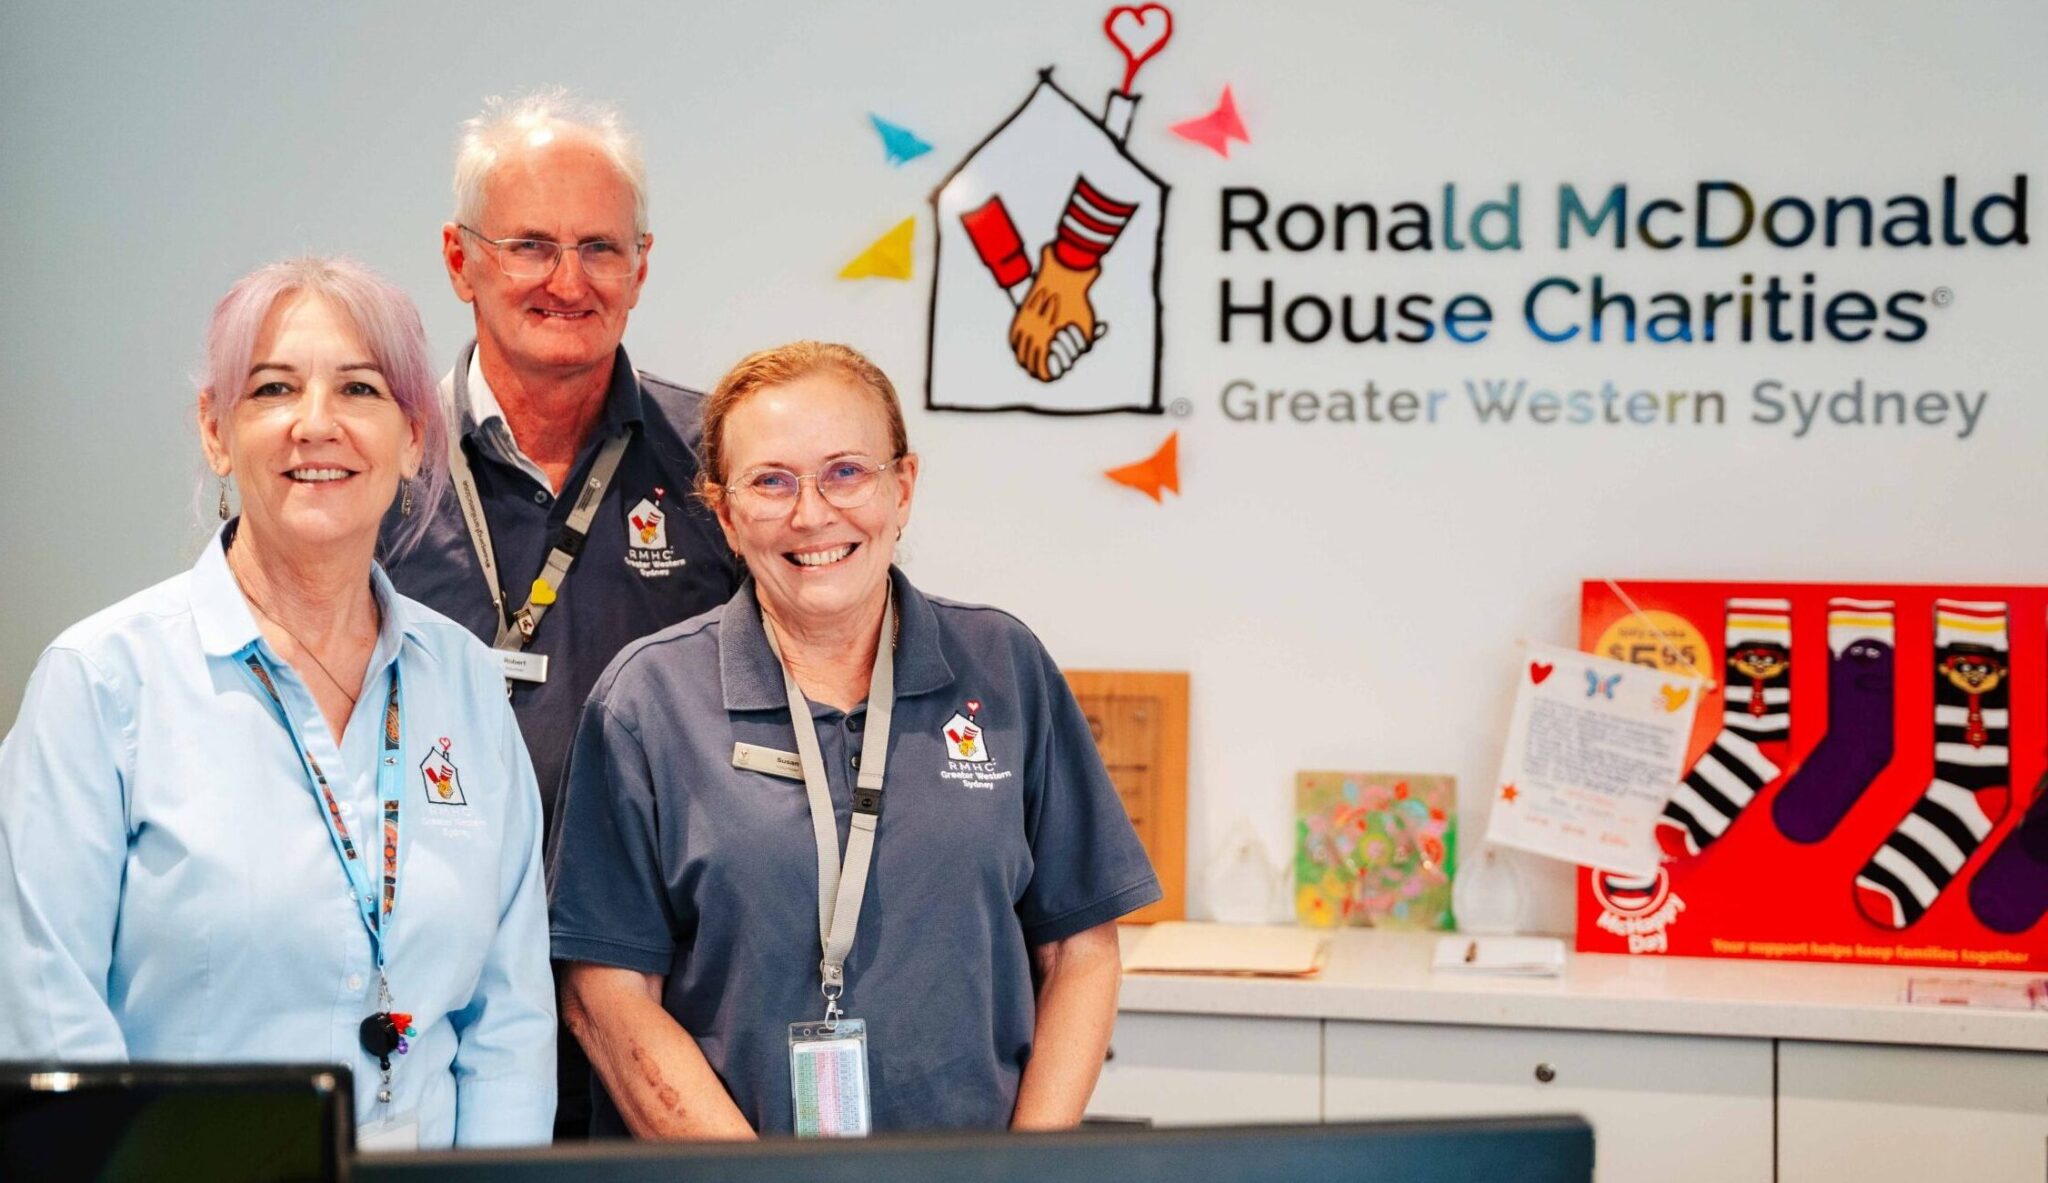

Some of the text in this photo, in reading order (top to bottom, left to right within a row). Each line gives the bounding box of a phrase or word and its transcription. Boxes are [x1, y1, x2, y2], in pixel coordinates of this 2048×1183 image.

[1219, 174, 2031, 253] Ronald McDonald
[1219, 278, 1495, 344] House
[1220, 379, 1444, 424] Greater
[1462, 379, 1726, 425] Western
[1750, 378, 1988, 438] Sydney
[776, 756, 800, 767] Susan
[940, 770, 1012, 780] Greater Western
[962, 779, 994, 790] Sydney
[1711, 938, 2030, 965] Your support helps keep families together
